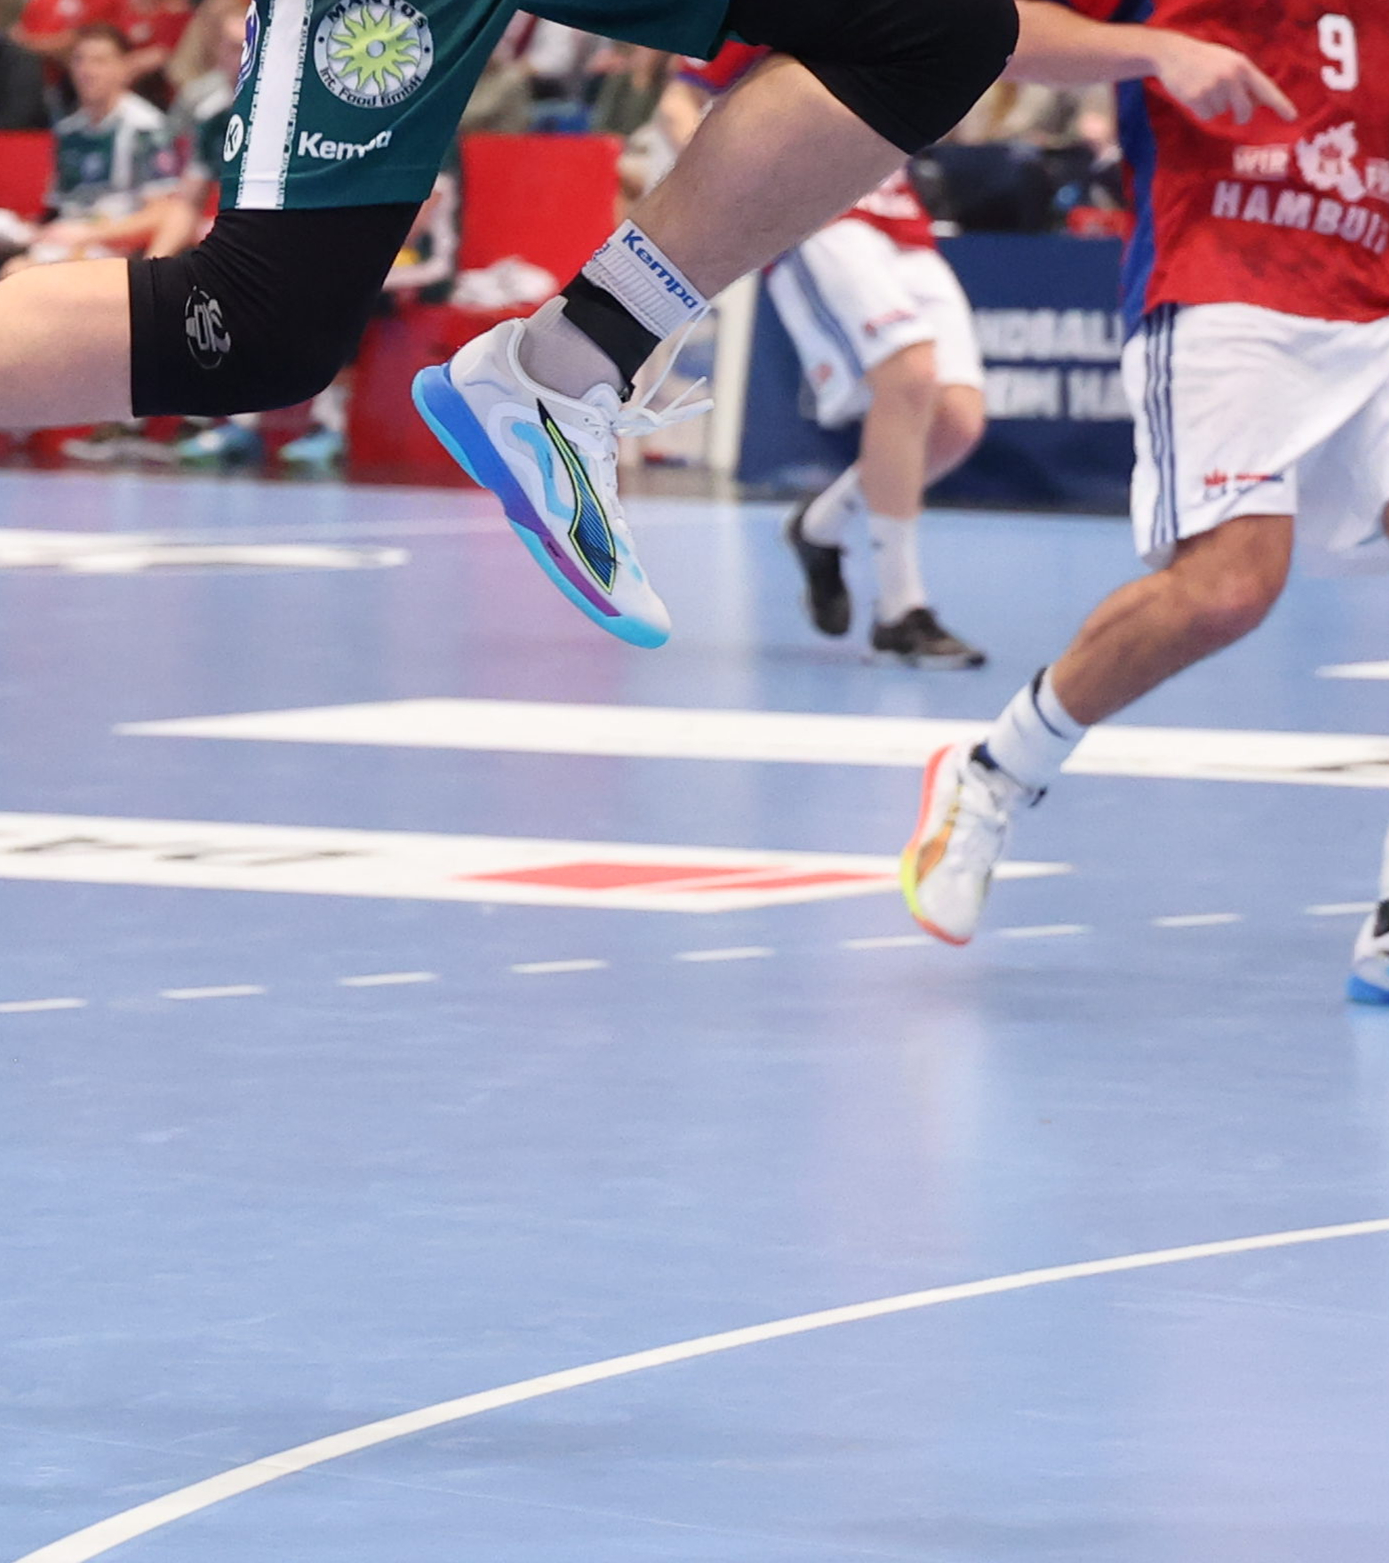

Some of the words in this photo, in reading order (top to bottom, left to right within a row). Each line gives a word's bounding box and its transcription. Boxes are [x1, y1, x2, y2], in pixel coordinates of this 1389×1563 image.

[1317, 13, 1359, 91] 9
[338, 88, 378, 107] Food
[621, 228, 699, 310] Kempa
